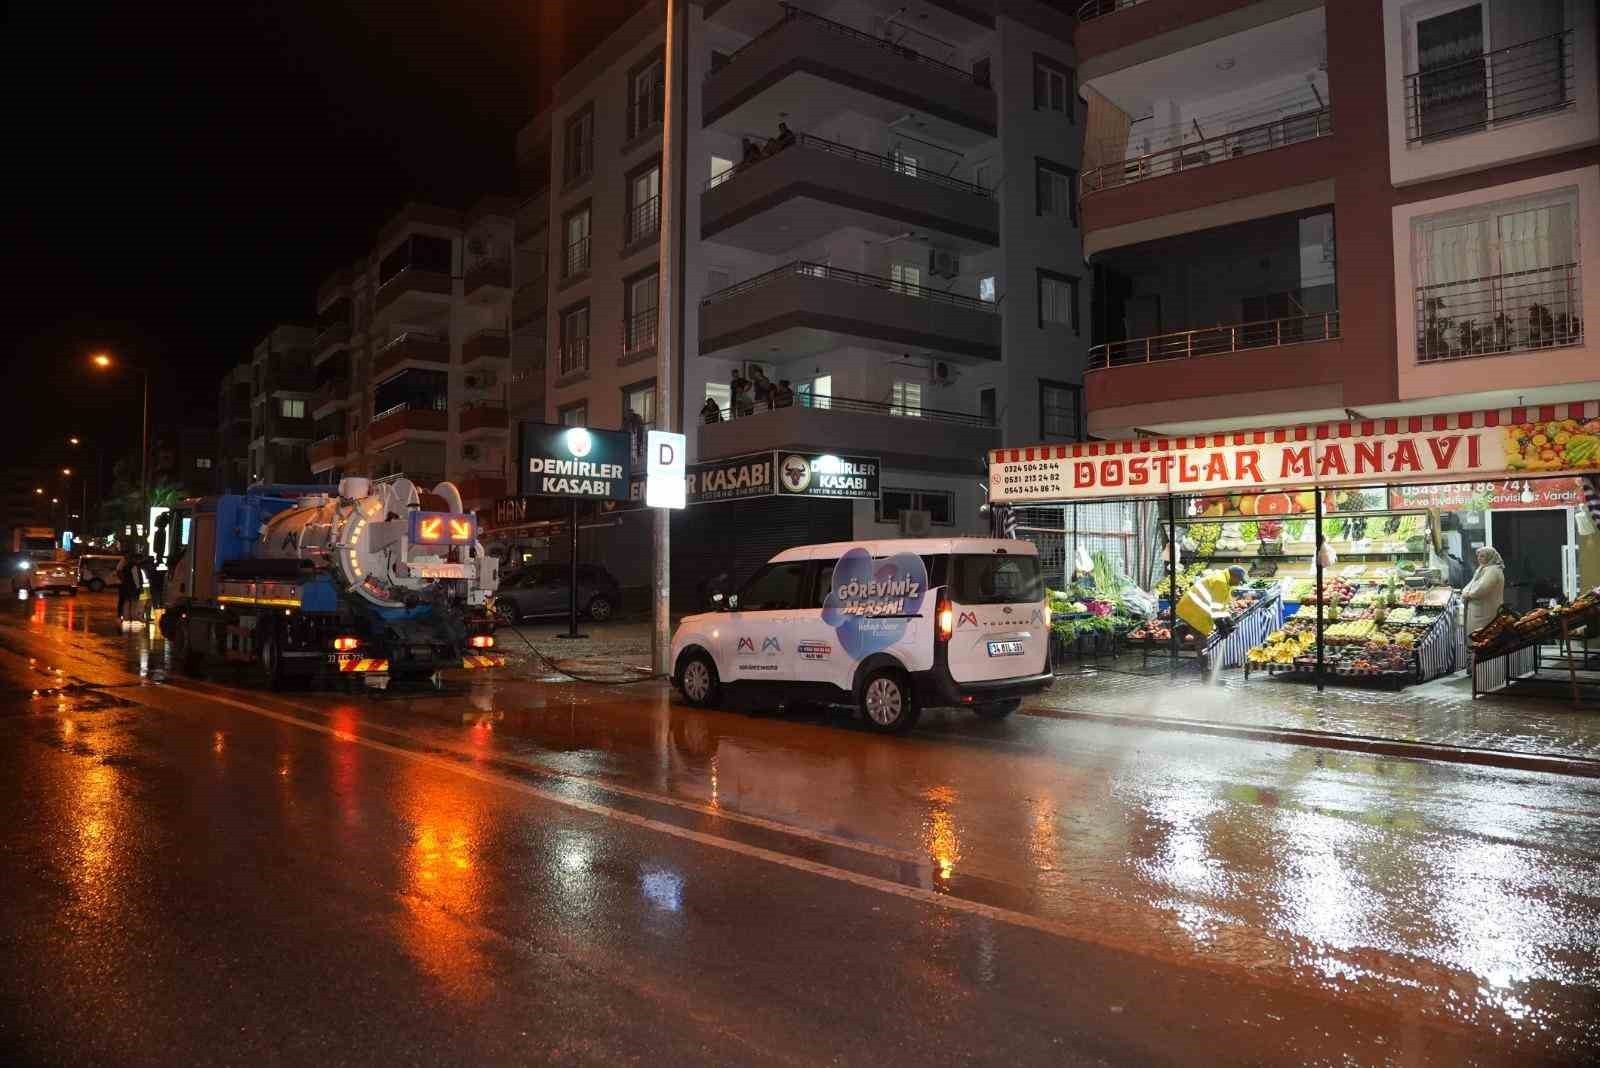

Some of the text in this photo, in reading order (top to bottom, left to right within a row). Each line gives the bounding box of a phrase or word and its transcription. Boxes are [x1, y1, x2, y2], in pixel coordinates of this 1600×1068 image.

[659, 443, 674, 466] D
[1073, 434, 1483, 489] DOSTLAR MANAVI
[529, 457, 623, 480] DEMİRLER
[702, 462, 770, 492] KASABI
[810, 459, 876, 476] DİRLER
[1004, 465, 1022, 473] 0324
[542, 477, 611, 496] KASABI
[819, 475, 867, 490] KASABI
[1004, 475, 1021, 484] 0531
[1024, 475, 1037, 483] 213
[1004, 486, 1023, 494] 0543
[1024, 485, 1039, 494] 434
[1051, 484, 1060, 492] 74
[838, 572, 920, 600] GÖREVİMİZ
